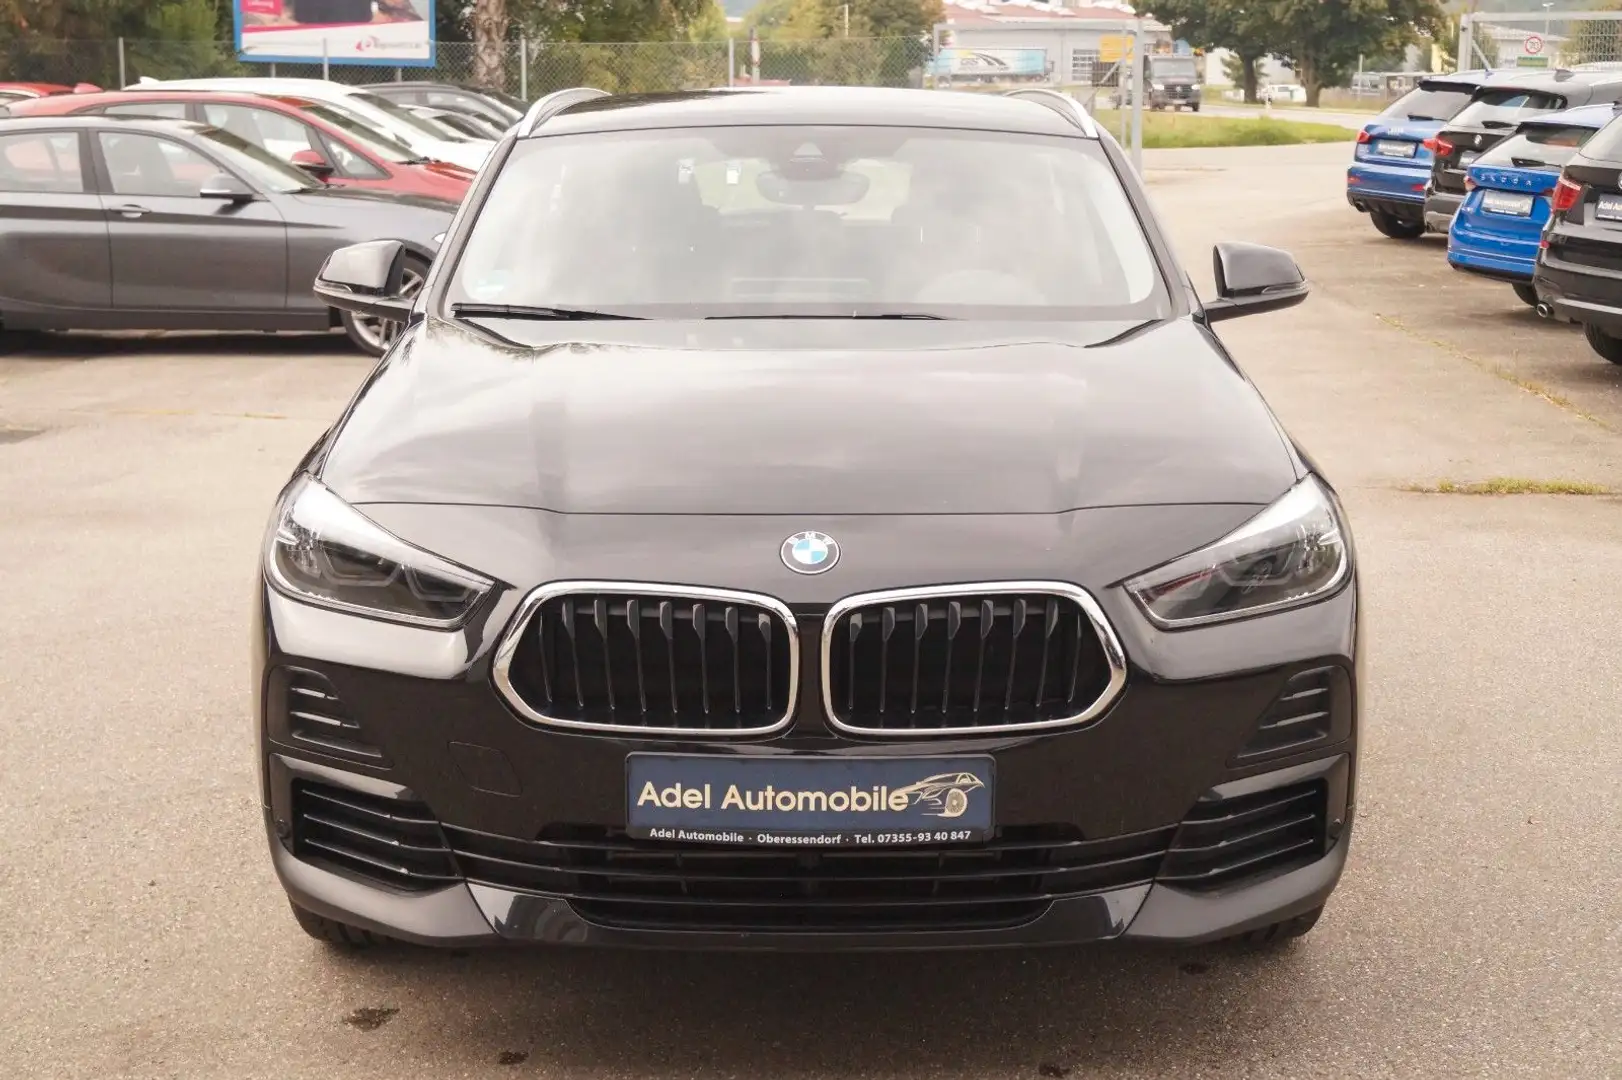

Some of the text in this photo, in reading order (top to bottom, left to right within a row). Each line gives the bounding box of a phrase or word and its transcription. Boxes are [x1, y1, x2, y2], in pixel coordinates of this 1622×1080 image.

[787, 532, 835, 545] BMW
[637, 781, 909, 812] Adel Automobile
[650, 828, 971, 845] Adel Automobile Oberessendorf Tel. 07355-93 40 847
